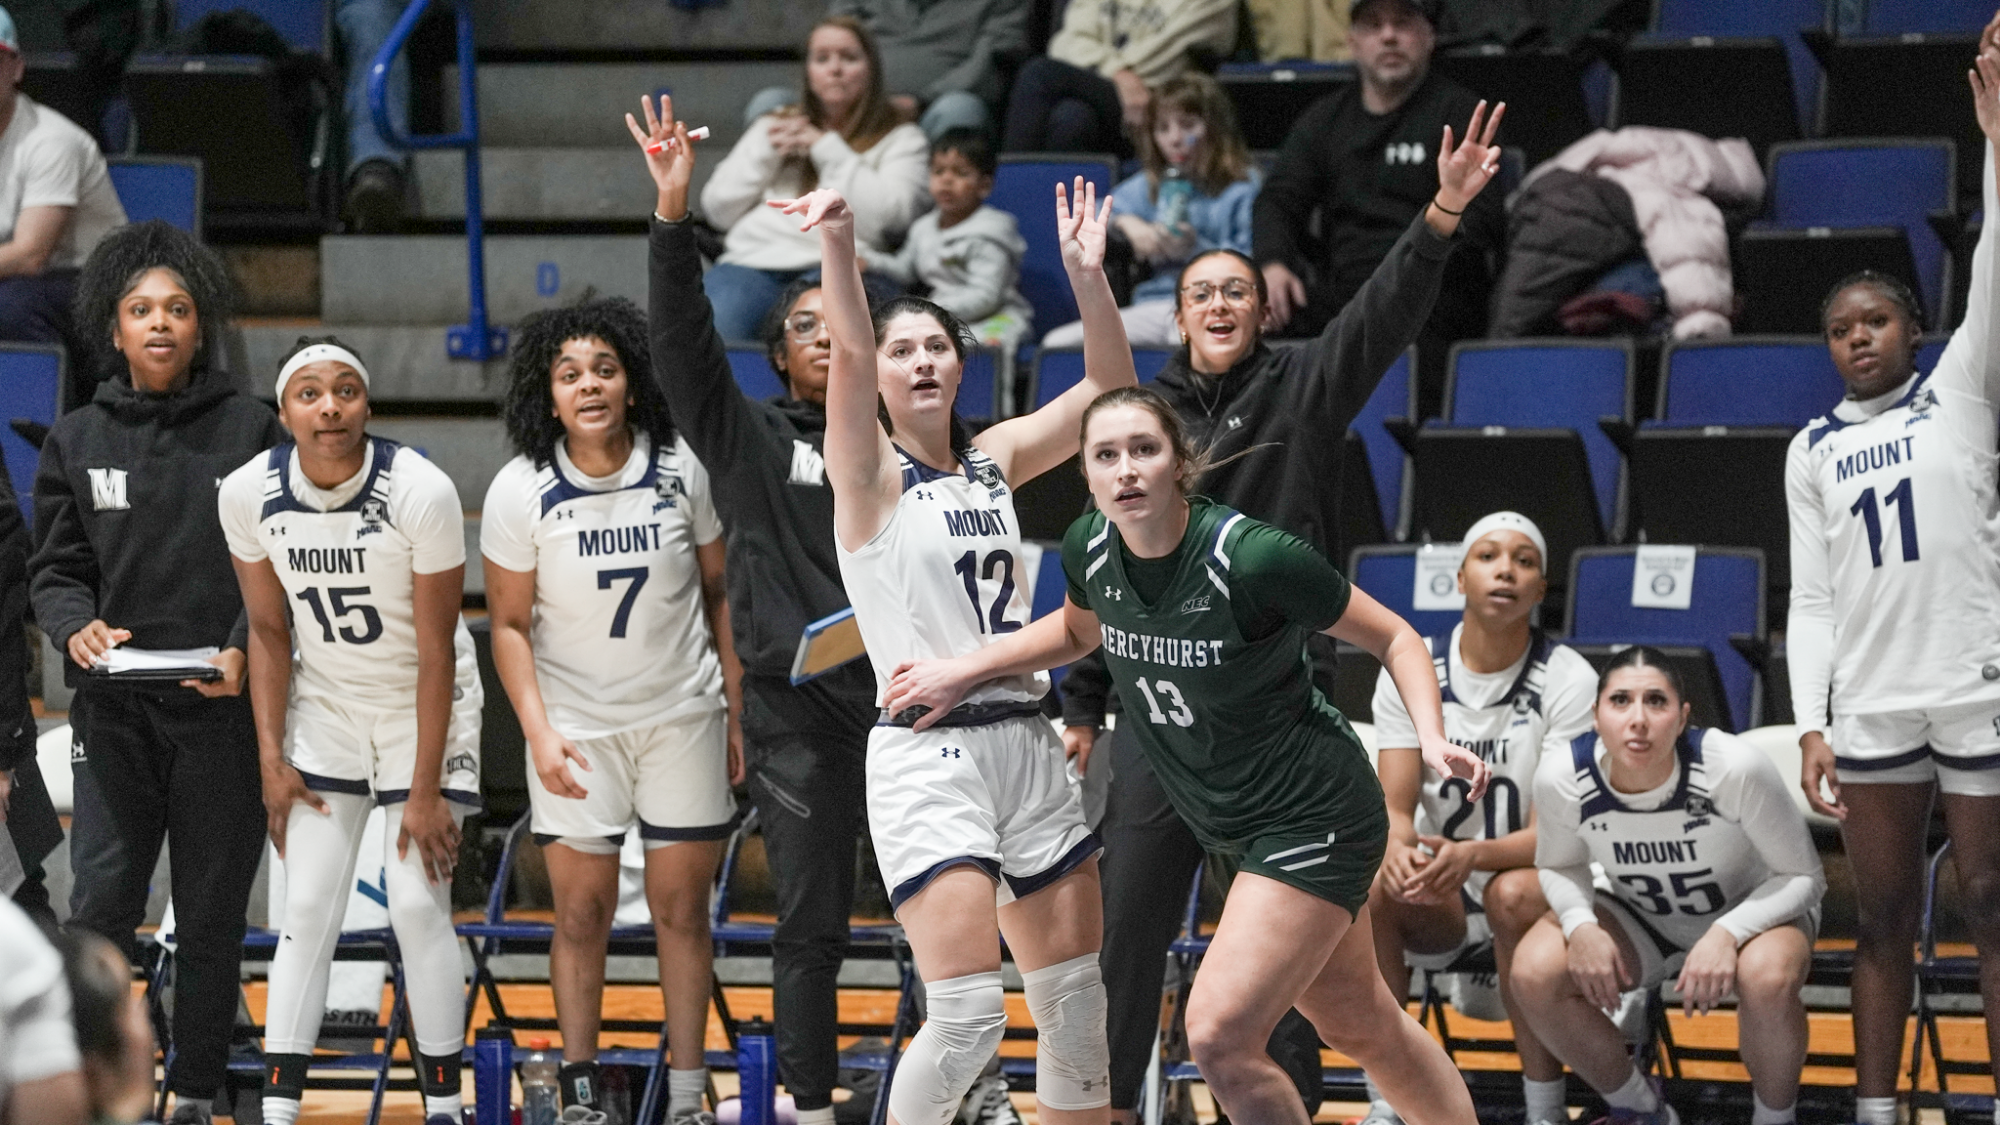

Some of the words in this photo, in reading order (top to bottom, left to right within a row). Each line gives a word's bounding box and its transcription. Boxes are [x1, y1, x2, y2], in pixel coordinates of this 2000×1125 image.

[786, 439, 825, 486] M
[1836, 435, 1915, 483] MOUNT
[87, 467, 131, 511] M
[578, 523, 661, 557] MOUNT
[943, 508, 1008, 537] MOUNT
[1850, 476, 1920, 569] 11
[288, 548, 366, 574] MOUNT
[296, 586, 383, 645] 15
[597, 566, 649, 638] 7
[954, 549, 1023, 634] 12
[1181, 595, 1210, 612] NEC
[1135, 676, 1194, 728] 13
[1439, 776, 1521, 842] 20
[1613, 840, 1697, 864] MOUNT
[1618, 867, 1726, 916] 35
